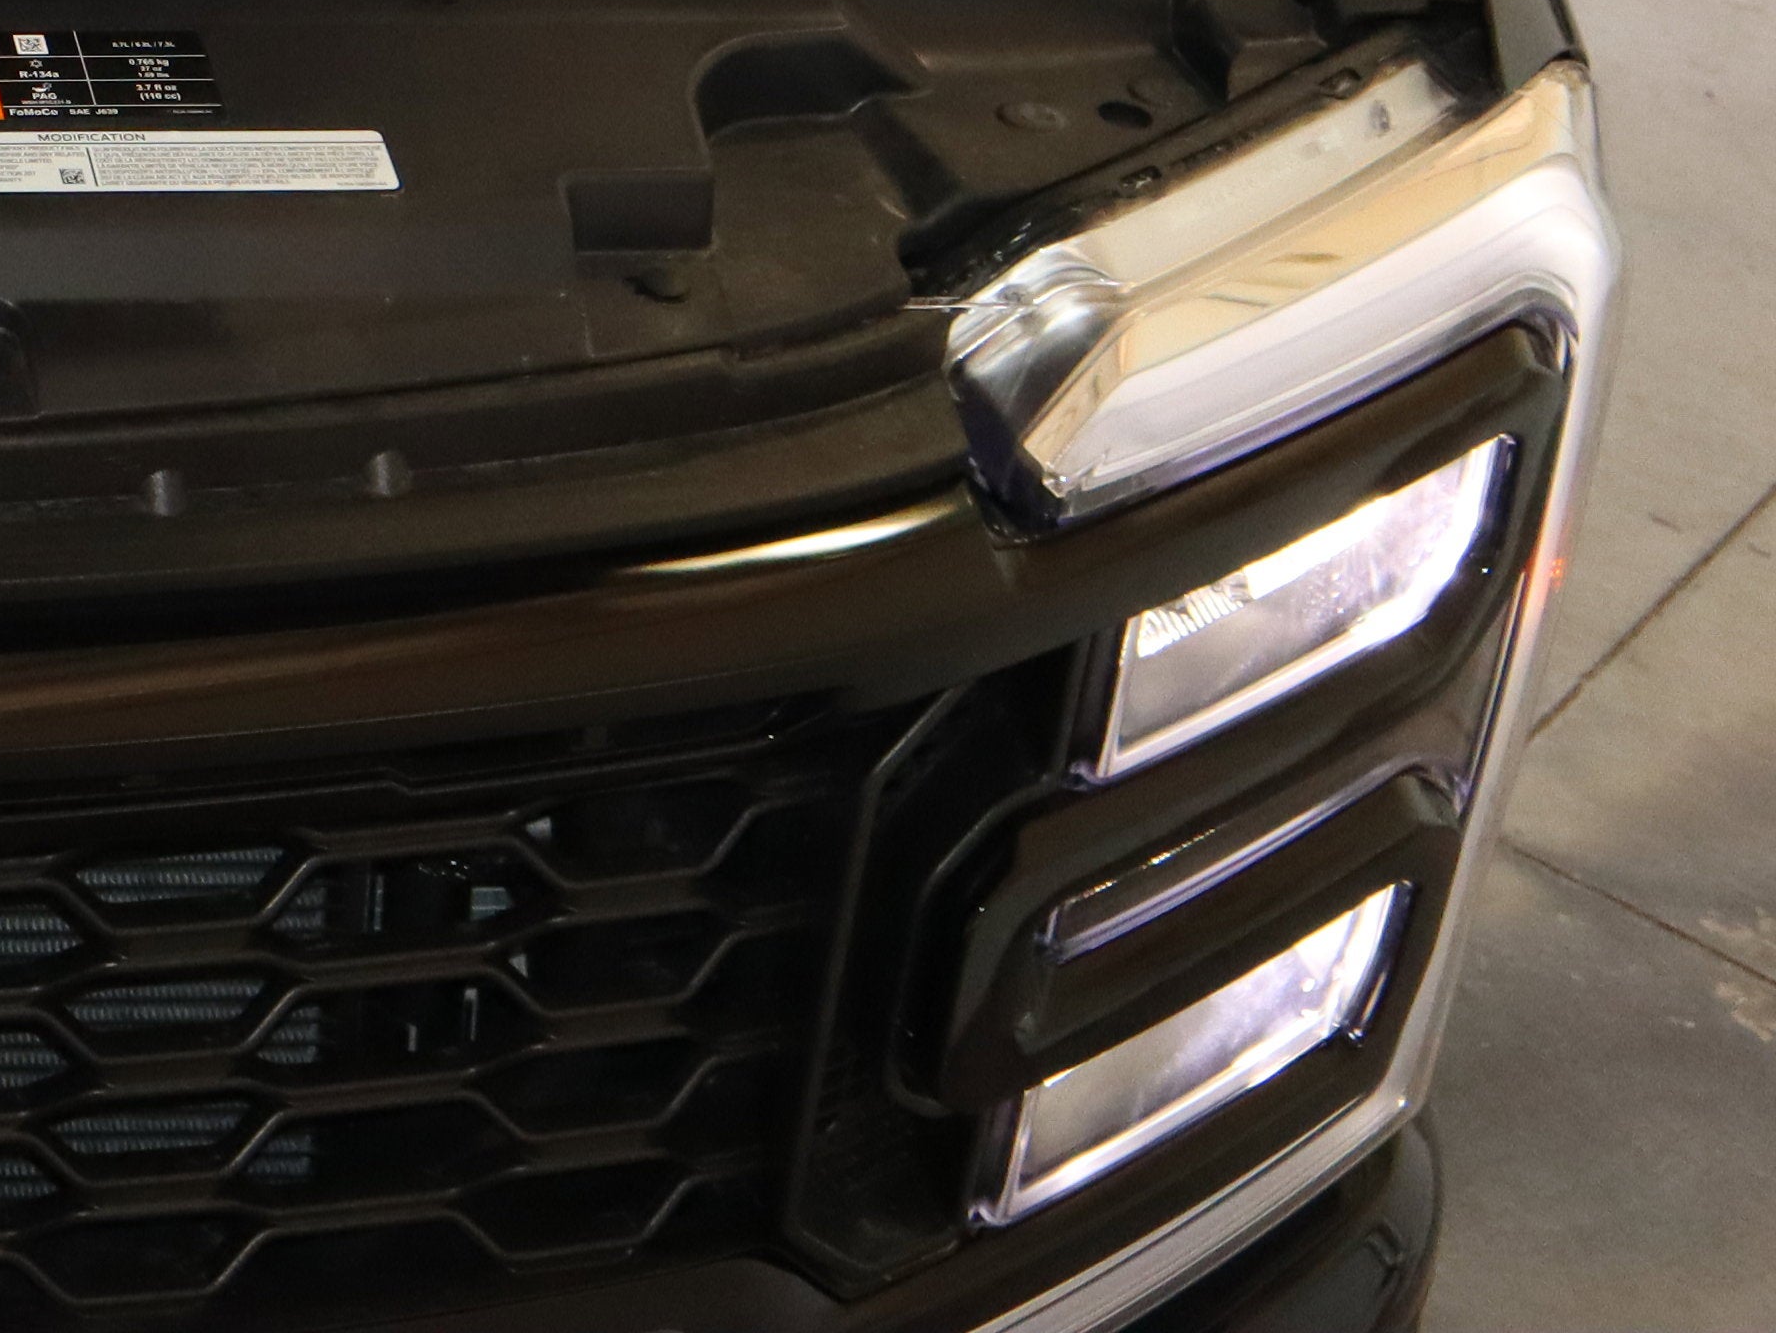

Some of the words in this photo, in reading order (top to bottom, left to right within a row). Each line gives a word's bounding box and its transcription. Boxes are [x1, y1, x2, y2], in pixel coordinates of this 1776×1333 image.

[19, 70, 60, 79] R-134a
[164, 93, 182, 101] cc)
[9, 108, 59, 116] FoMoCo
[69, 108, 91, 116] SAE
[37, 133, 146, 142] MODIFICATION
